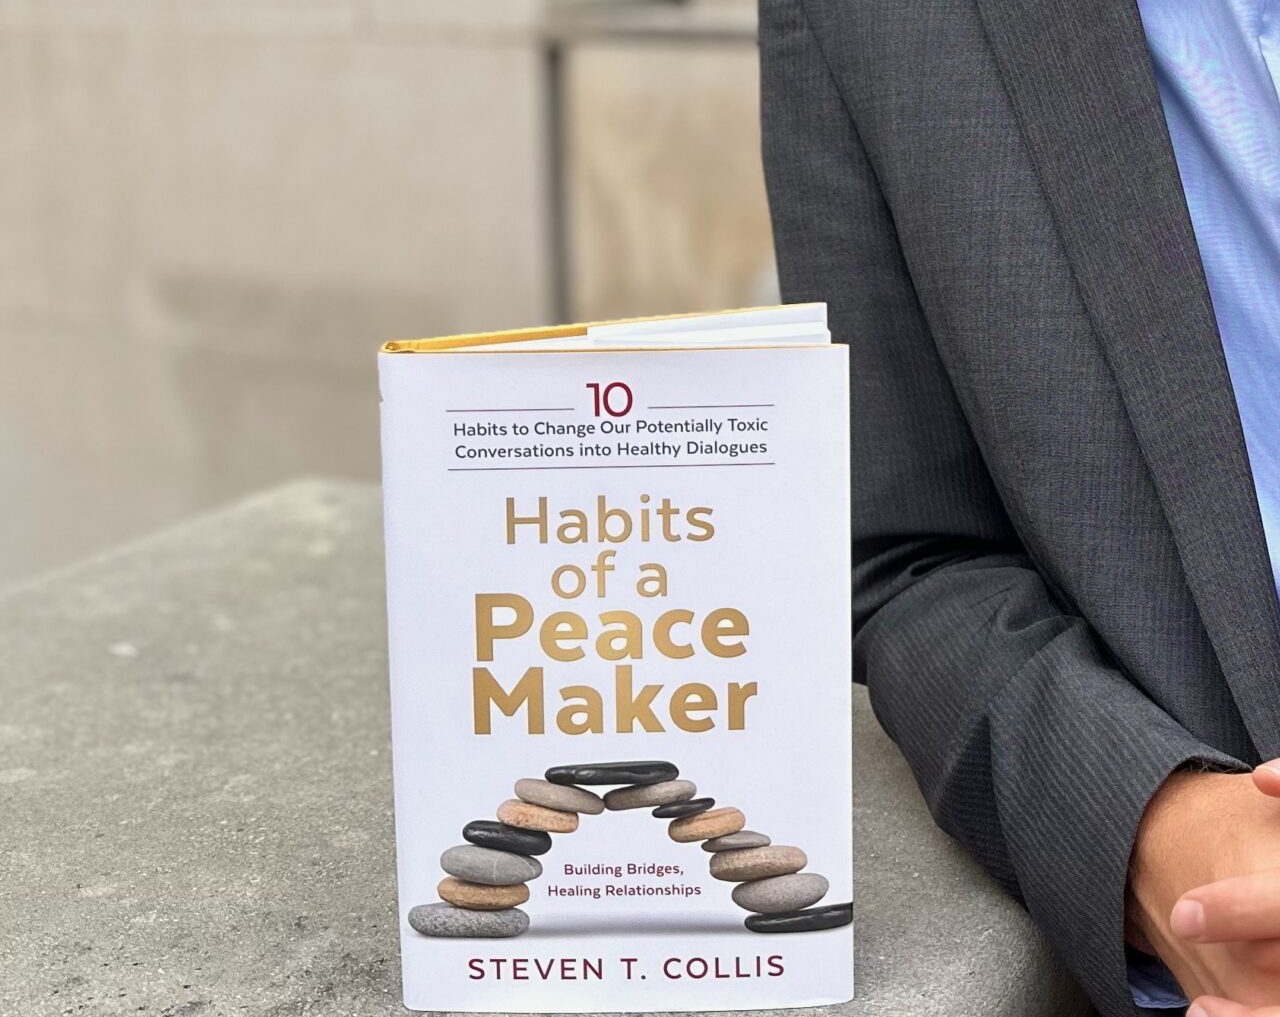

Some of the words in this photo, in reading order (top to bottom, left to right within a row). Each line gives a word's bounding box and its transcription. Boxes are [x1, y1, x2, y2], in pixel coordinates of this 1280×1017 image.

[586, 382, 633, 418] 10
[453, 421, 508, 437] Habits
[511, 422, 530, 436] to
[533, 420, 596, 438] Change
[599, 420, 631, 435] Our
[636, 418, 723, 436] Potentially
[727, 417, 769, 432] Toxic
[454, 443, 575, 459] Conversations
[579, 442, 612, 457] into
[617, 441, 682, 459] Healthy
[686, 440, 768, 457] Dialogues
[505, 494, 715, 545] Habits
[550, 550, 617, 599] of
[635, 562, 668, 599] a
[474, 593, 750, 663] Peace
[472, 664, 758, 736] Maker
[563, 863, 623, 878] Building
[626, 862, 685, 878] Bridges,
[547, 884, 602, 900] Healing
[605, 882, 702, 898] Relationships
[468, 957, 604, 981] STEVEN
[620, 957, 647, 981] T.
[662, 954, 785, 980] COLLIS
